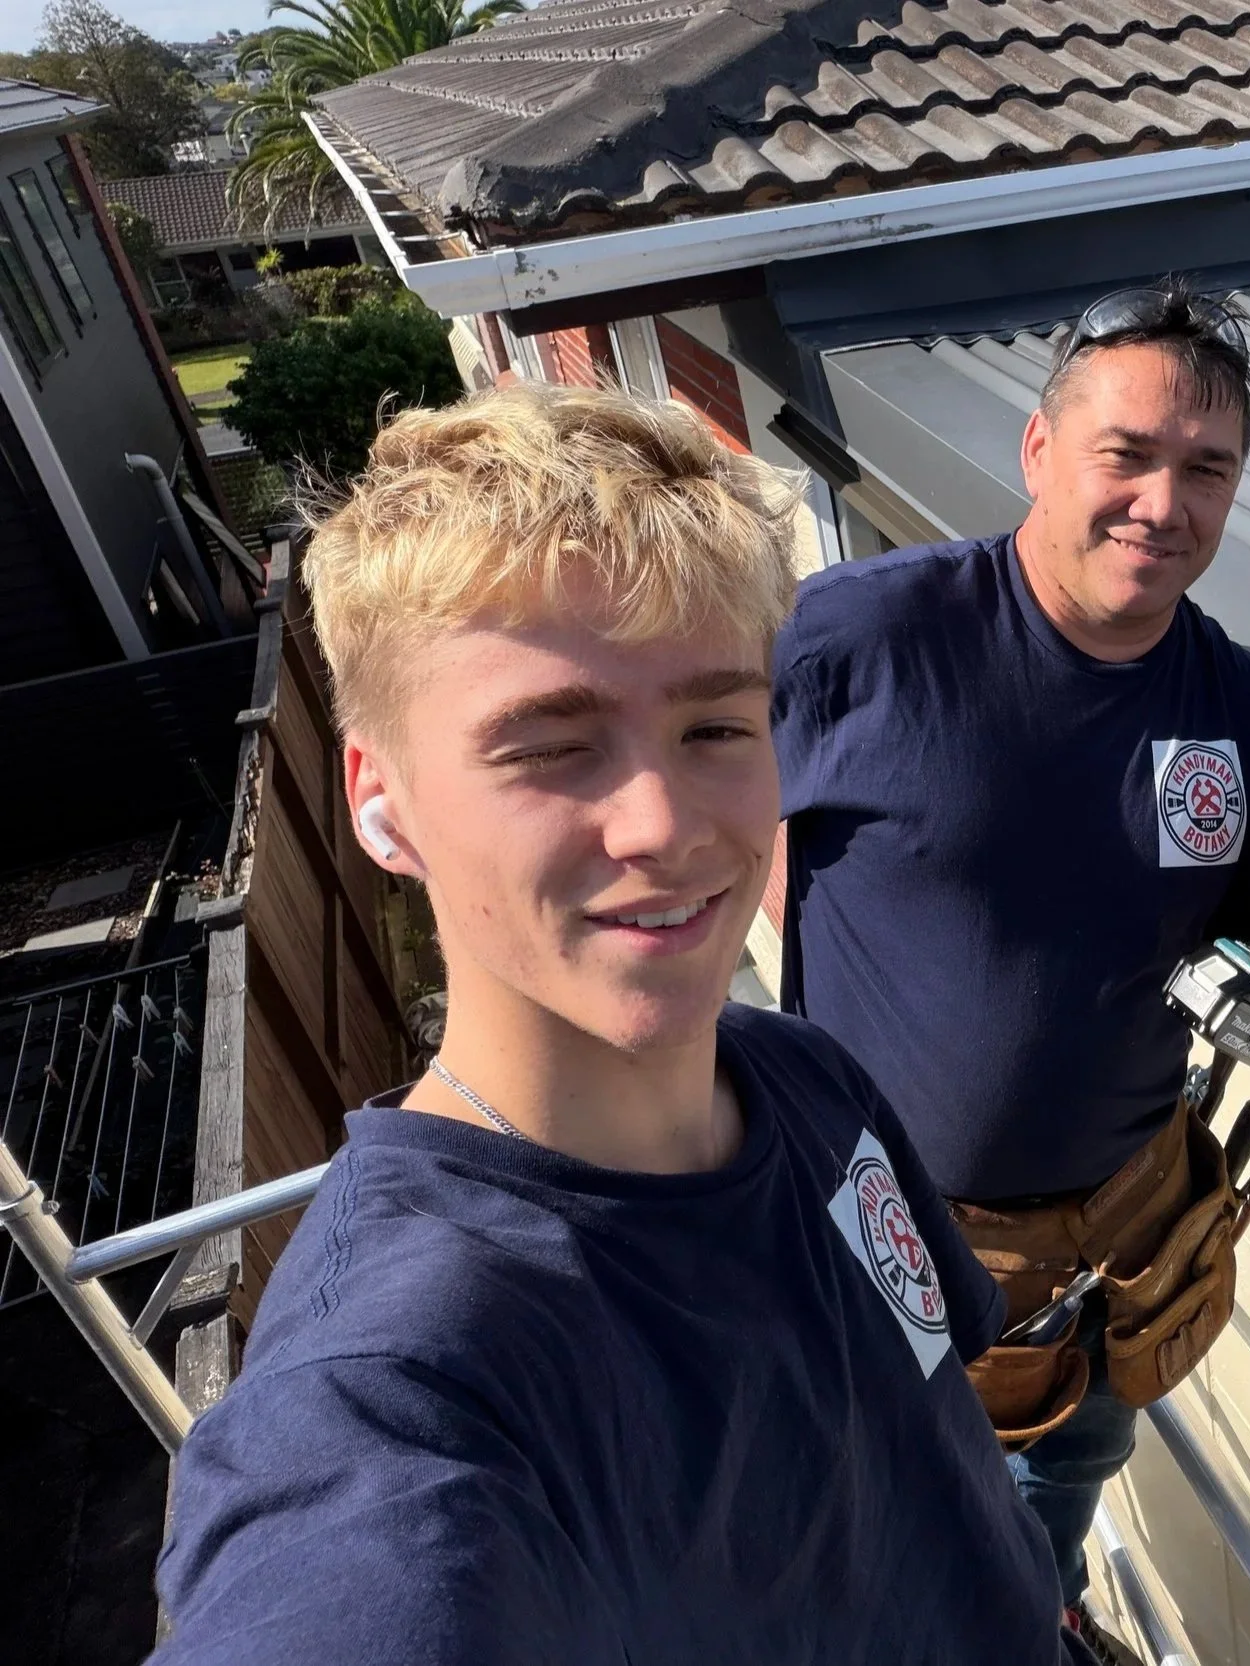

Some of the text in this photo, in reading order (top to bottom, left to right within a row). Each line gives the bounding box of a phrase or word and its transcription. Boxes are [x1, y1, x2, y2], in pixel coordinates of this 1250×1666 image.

[1173, 753, 1233, 786] HANDYMAN
[1201, 819, 1218, 829] 2014
[1183, 825, 1231, 853] BOTANY
